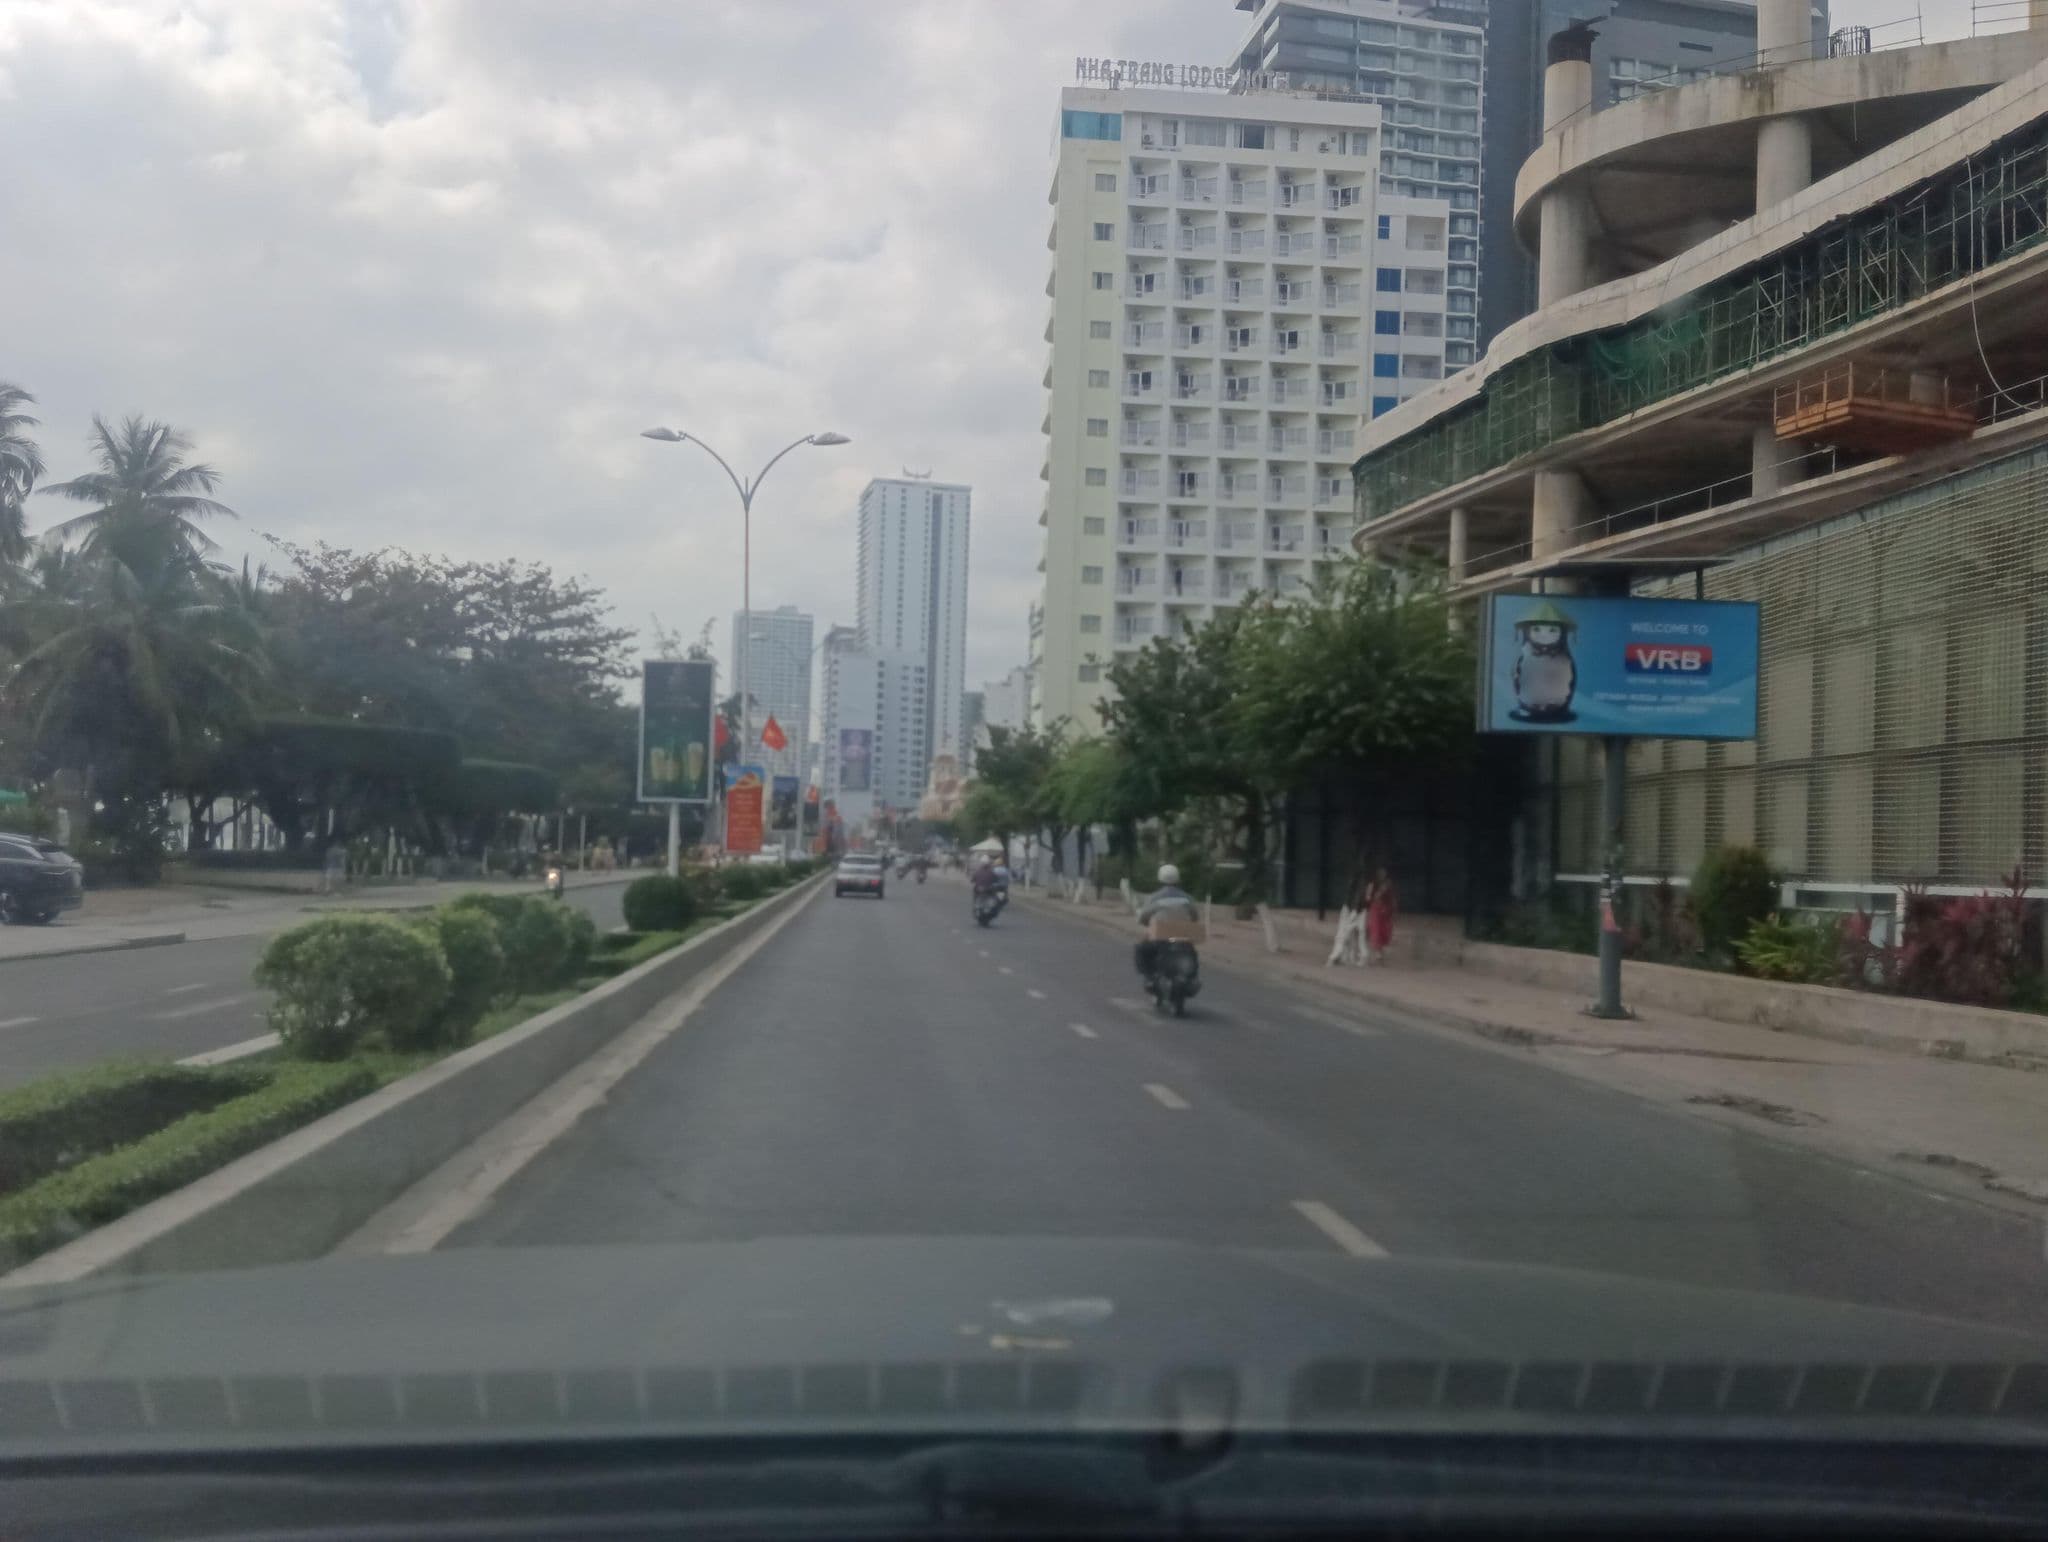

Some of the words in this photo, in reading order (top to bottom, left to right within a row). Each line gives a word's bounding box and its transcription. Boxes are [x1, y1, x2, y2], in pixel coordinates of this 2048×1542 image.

[1076, 57, 1111, 81] NHA
[1118, 60, 1174, 84] TRANG
[1181, 64, 1233, 89] LODGE
[1631, 622, 1689, 635] WELCOME
[1693, 624, 1709, 635] TO
[1636, 648, 1702, 671] VRB
